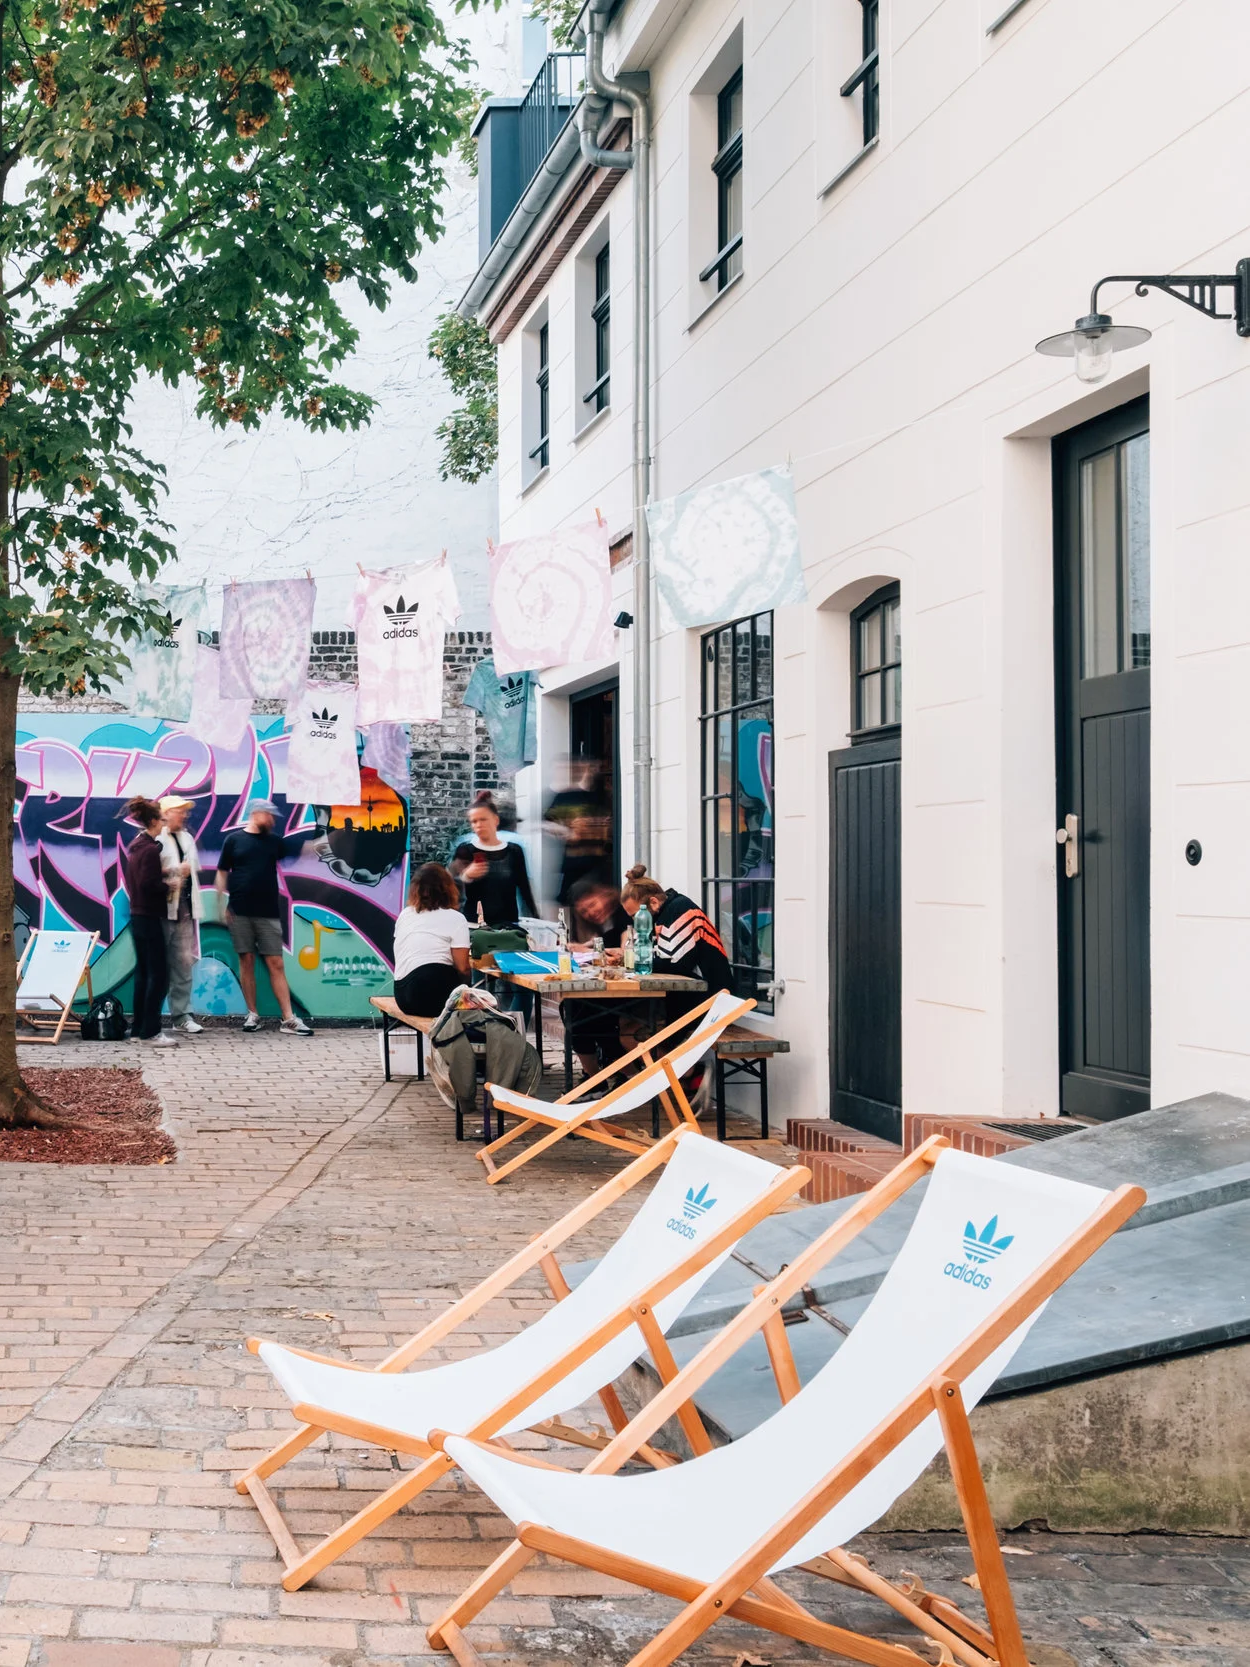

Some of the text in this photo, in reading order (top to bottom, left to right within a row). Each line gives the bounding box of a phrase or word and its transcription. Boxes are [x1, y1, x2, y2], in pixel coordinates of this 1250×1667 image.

[383, 628, 418, 640] adidas
[310, 730, 337, 740] adidas
[666, 1218, 697, 1240] adidas
[944, 1262, 992, 1289] adidas
